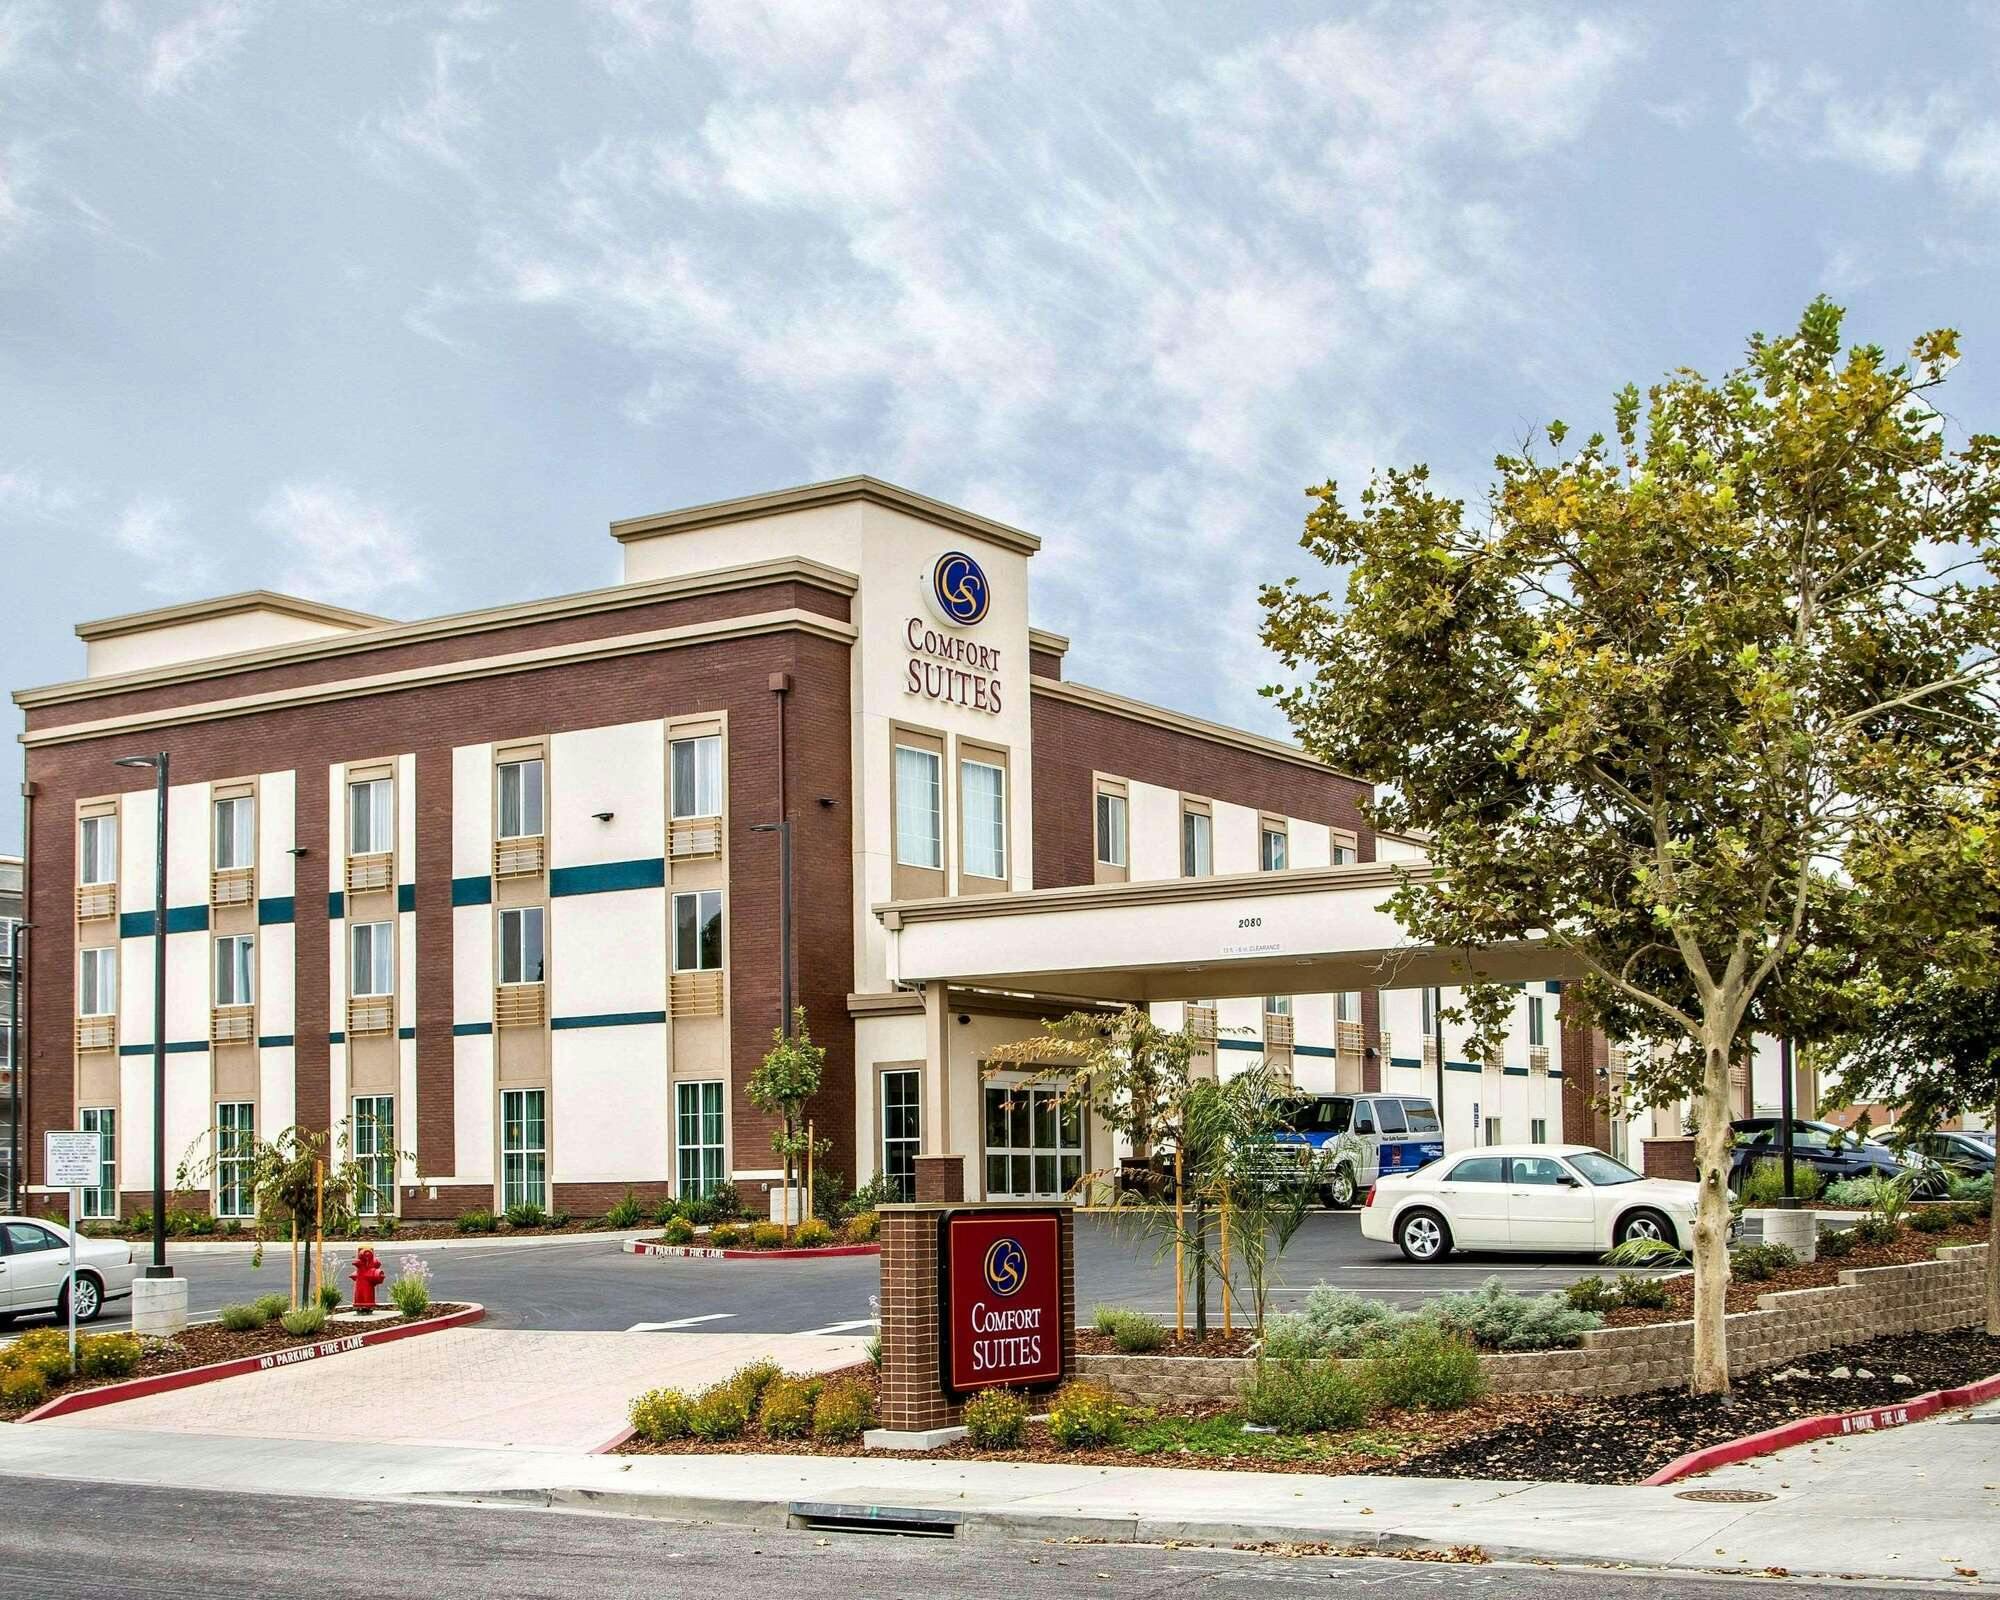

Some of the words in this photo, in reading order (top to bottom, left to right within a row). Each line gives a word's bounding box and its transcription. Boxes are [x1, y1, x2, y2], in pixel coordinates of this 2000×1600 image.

[907, 617, 1001, 672] COMFORT
[908, 658, 1002, 714] SUITES
[1238, 917, 1262, 928] 2080
[1249, 943, 1280, 952] CLEARANCE
[644, 1246, 654, 1256] NO
[655, 1246, 685, 1256] PARKING
[689, 1248, 705, 1258] FIRE
[706, 1248, 725, 1259] LANE
[971, 1302, 1041, 1333] COMFORT
[260, 1357, 274, 1369] NO
[276, 1347, 315, 1366] PARKING
[320, 1341, 339, 1355] FIRE
[341, 1335, 364, 1351] LANE
[973, 1335, 1041, 1370] SUITES
